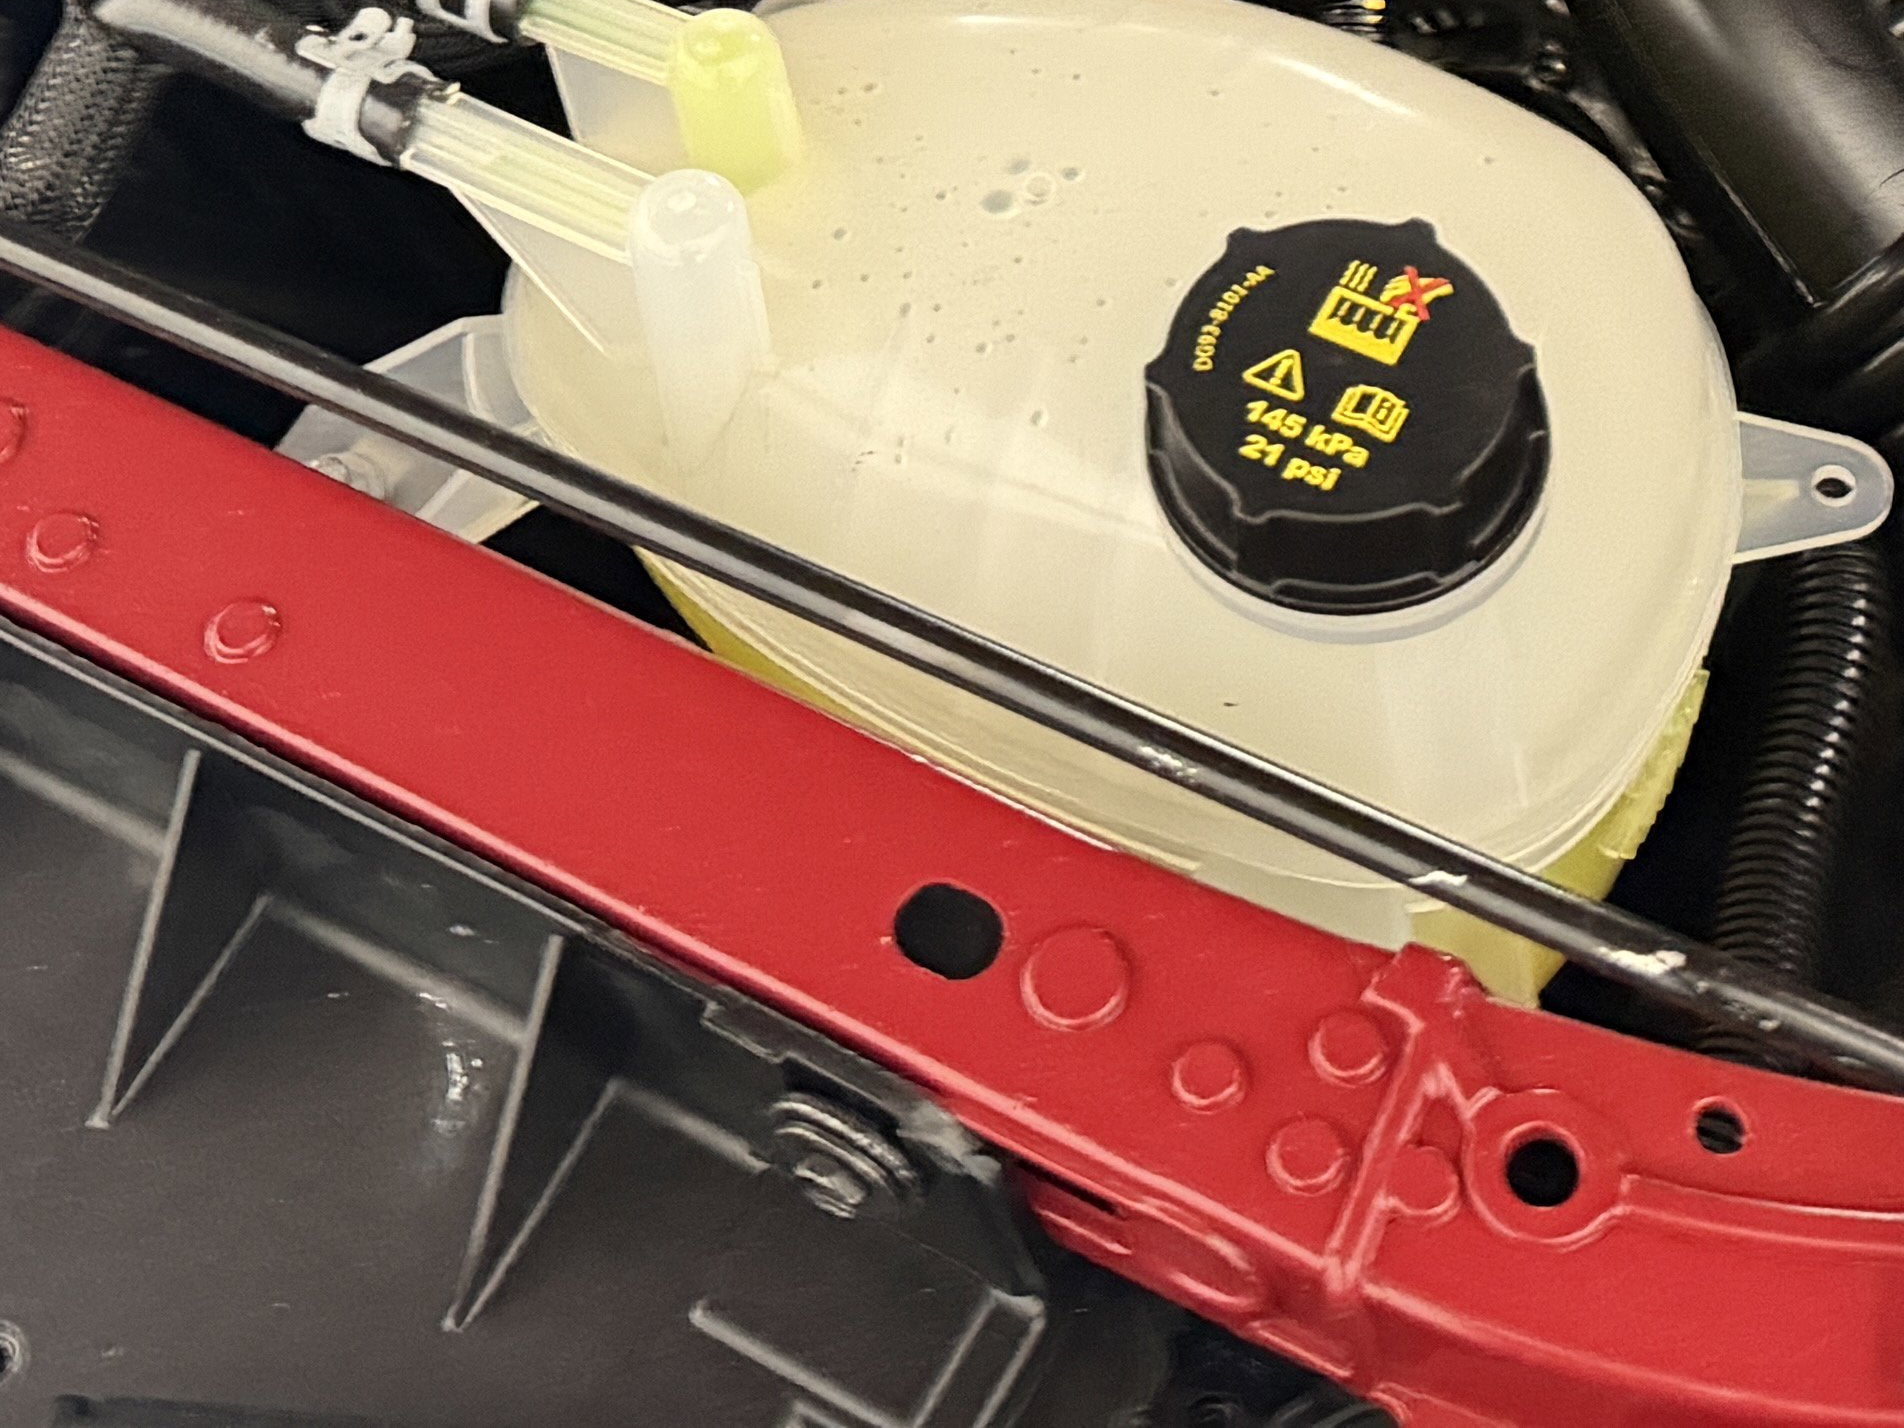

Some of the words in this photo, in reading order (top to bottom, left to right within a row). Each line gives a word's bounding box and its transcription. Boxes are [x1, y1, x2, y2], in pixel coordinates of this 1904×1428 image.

[1238, 434, 1285, 467] 21
[1281, 457, 1342, 491] psi
[1246, 400, 1307, 438] 145
[1304, 424, 1370, 468] kPa
